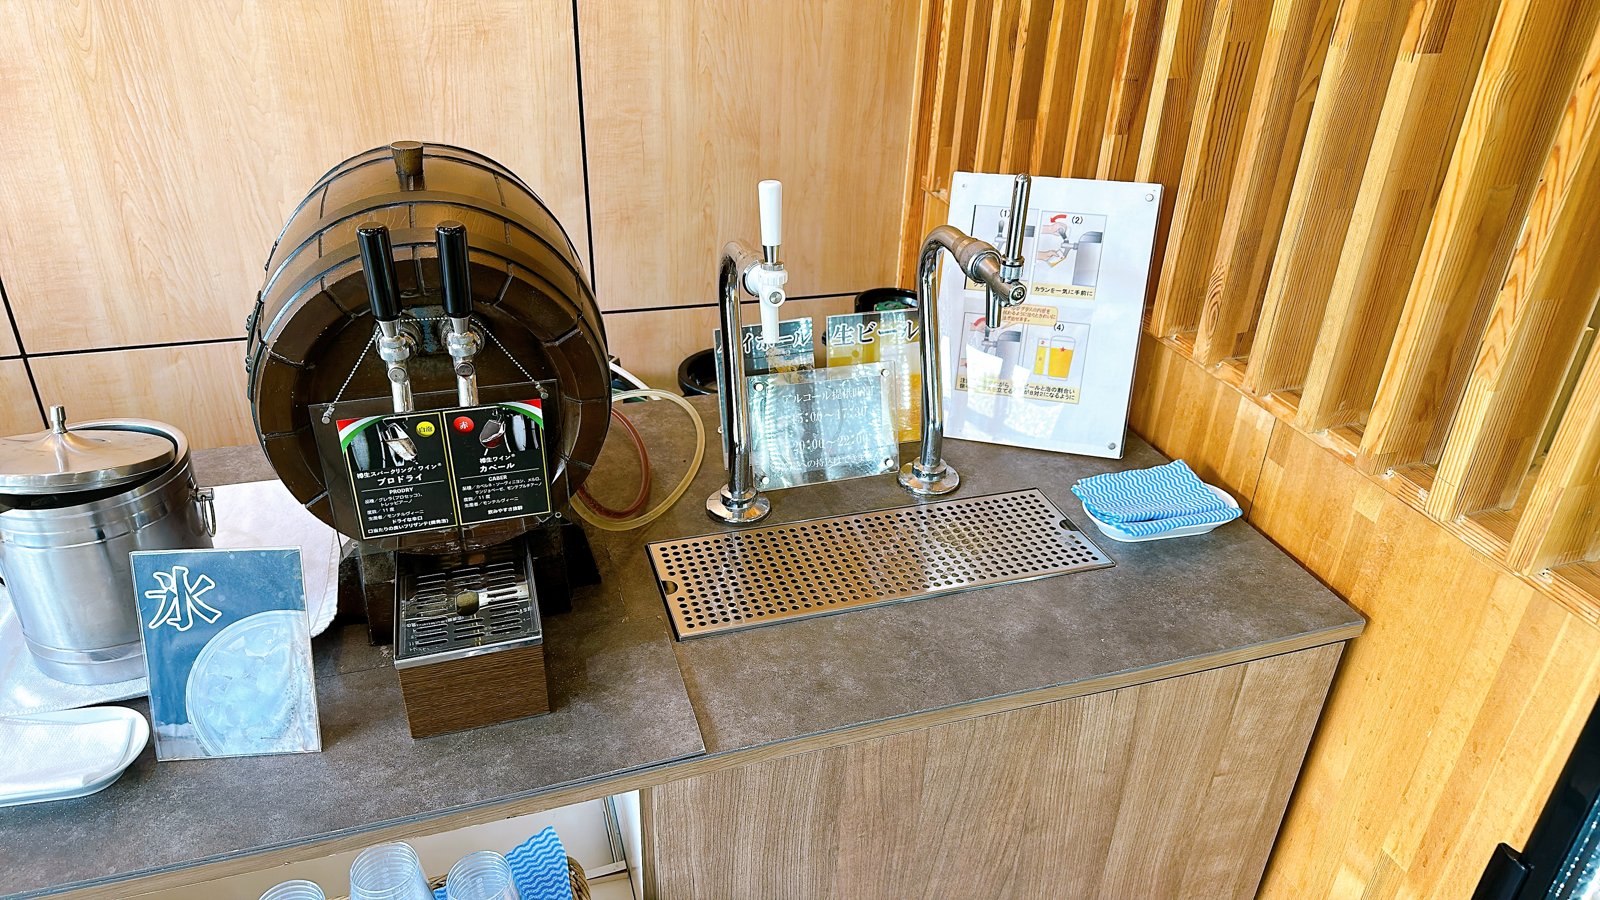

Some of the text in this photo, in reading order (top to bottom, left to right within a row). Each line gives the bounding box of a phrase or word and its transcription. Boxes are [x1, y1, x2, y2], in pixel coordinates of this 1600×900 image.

[1071, 215, 1084, 225] (2)
[1034, 286, 1093, 297] カランを一気に手前に
[1053, 323, 1065, 332] (4)
[831, 320, 919, 346] 生ビール
[480, 463, 515, 473] カベール
[144, 565, 222, 631] 氷
